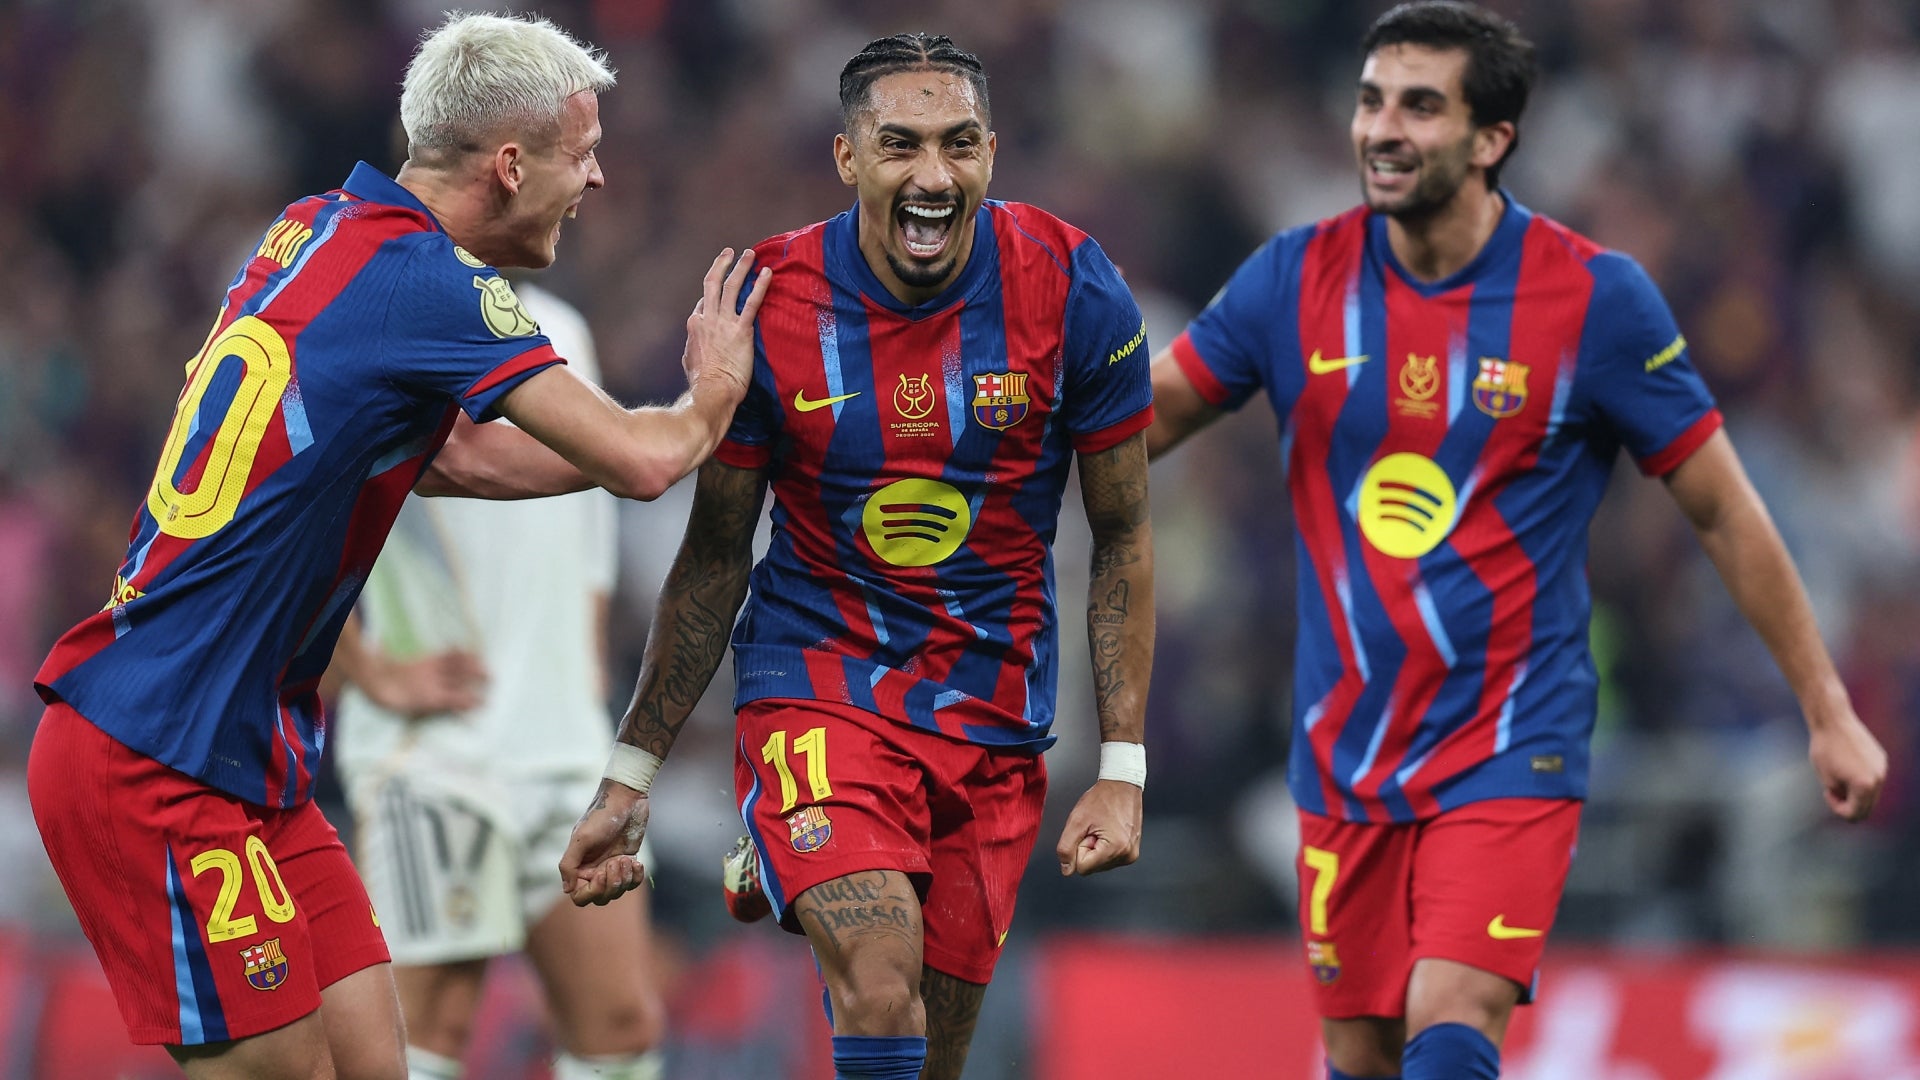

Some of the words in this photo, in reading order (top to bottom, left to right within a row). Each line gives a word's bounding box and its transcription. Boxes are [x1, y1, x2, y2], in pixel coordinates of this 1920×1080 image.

[147, 305, 292, 539] 0
[990, 397, 1013, 405] FCB
[761, 727, 834, 813] 11
[190, 835, 296, 944] 20
[1304, 846, 1339, 935] 7
[258, 961, 275, 971] FCB
